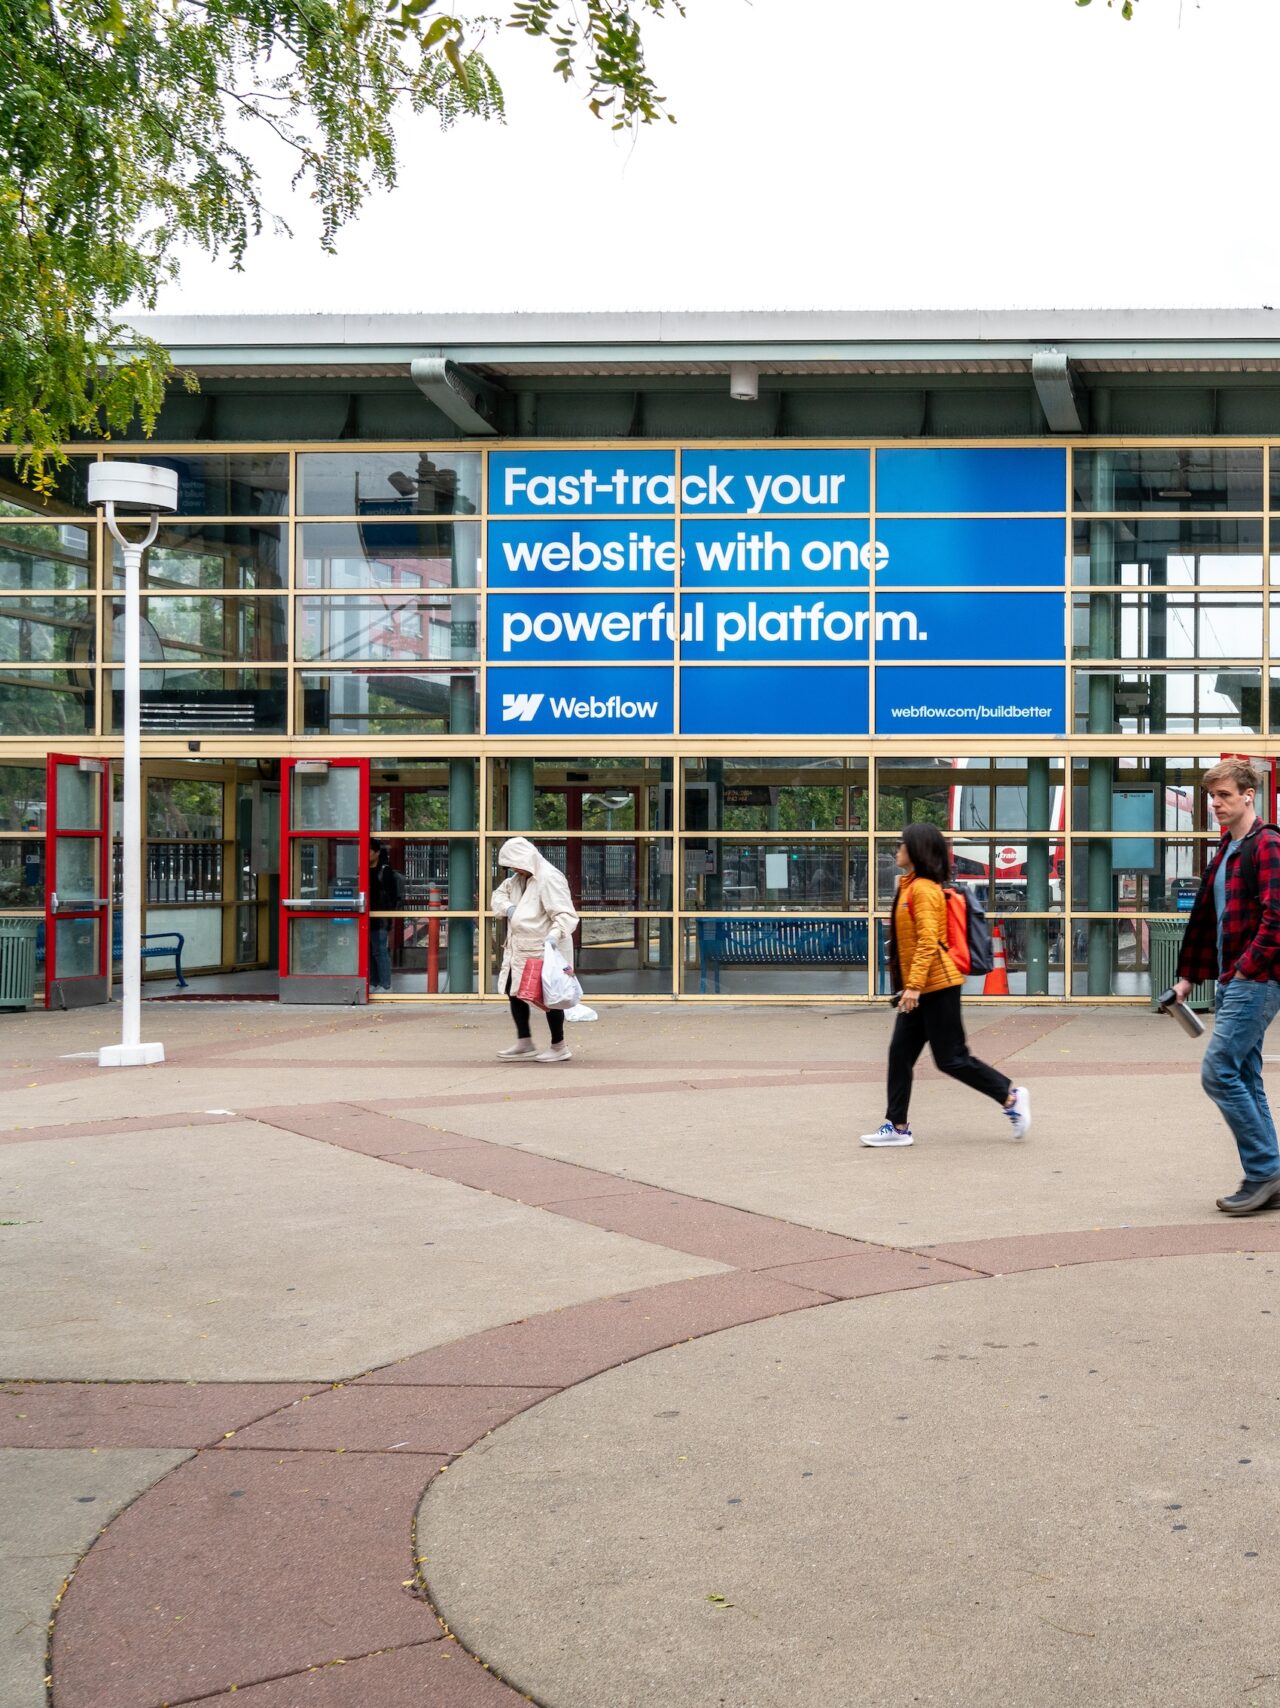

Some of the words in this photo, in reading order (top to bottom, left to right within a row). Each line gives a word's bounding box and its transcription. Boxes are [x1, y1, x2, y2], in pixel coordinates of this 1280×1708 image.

[504, 466, 735, 505] Fast-track
[746, 474, 845, 514] your
[503, 532, 686, 572] website
[696, 532, 790, 571] with
[802, 541, 889, 571] one
[503, 602, 704, 652] powerful
[716, 602, 928, 652] platform.
[550, 697, 658, 719] Webflow
[891, 705, 1052, 720] webflow.com/buildbetter
